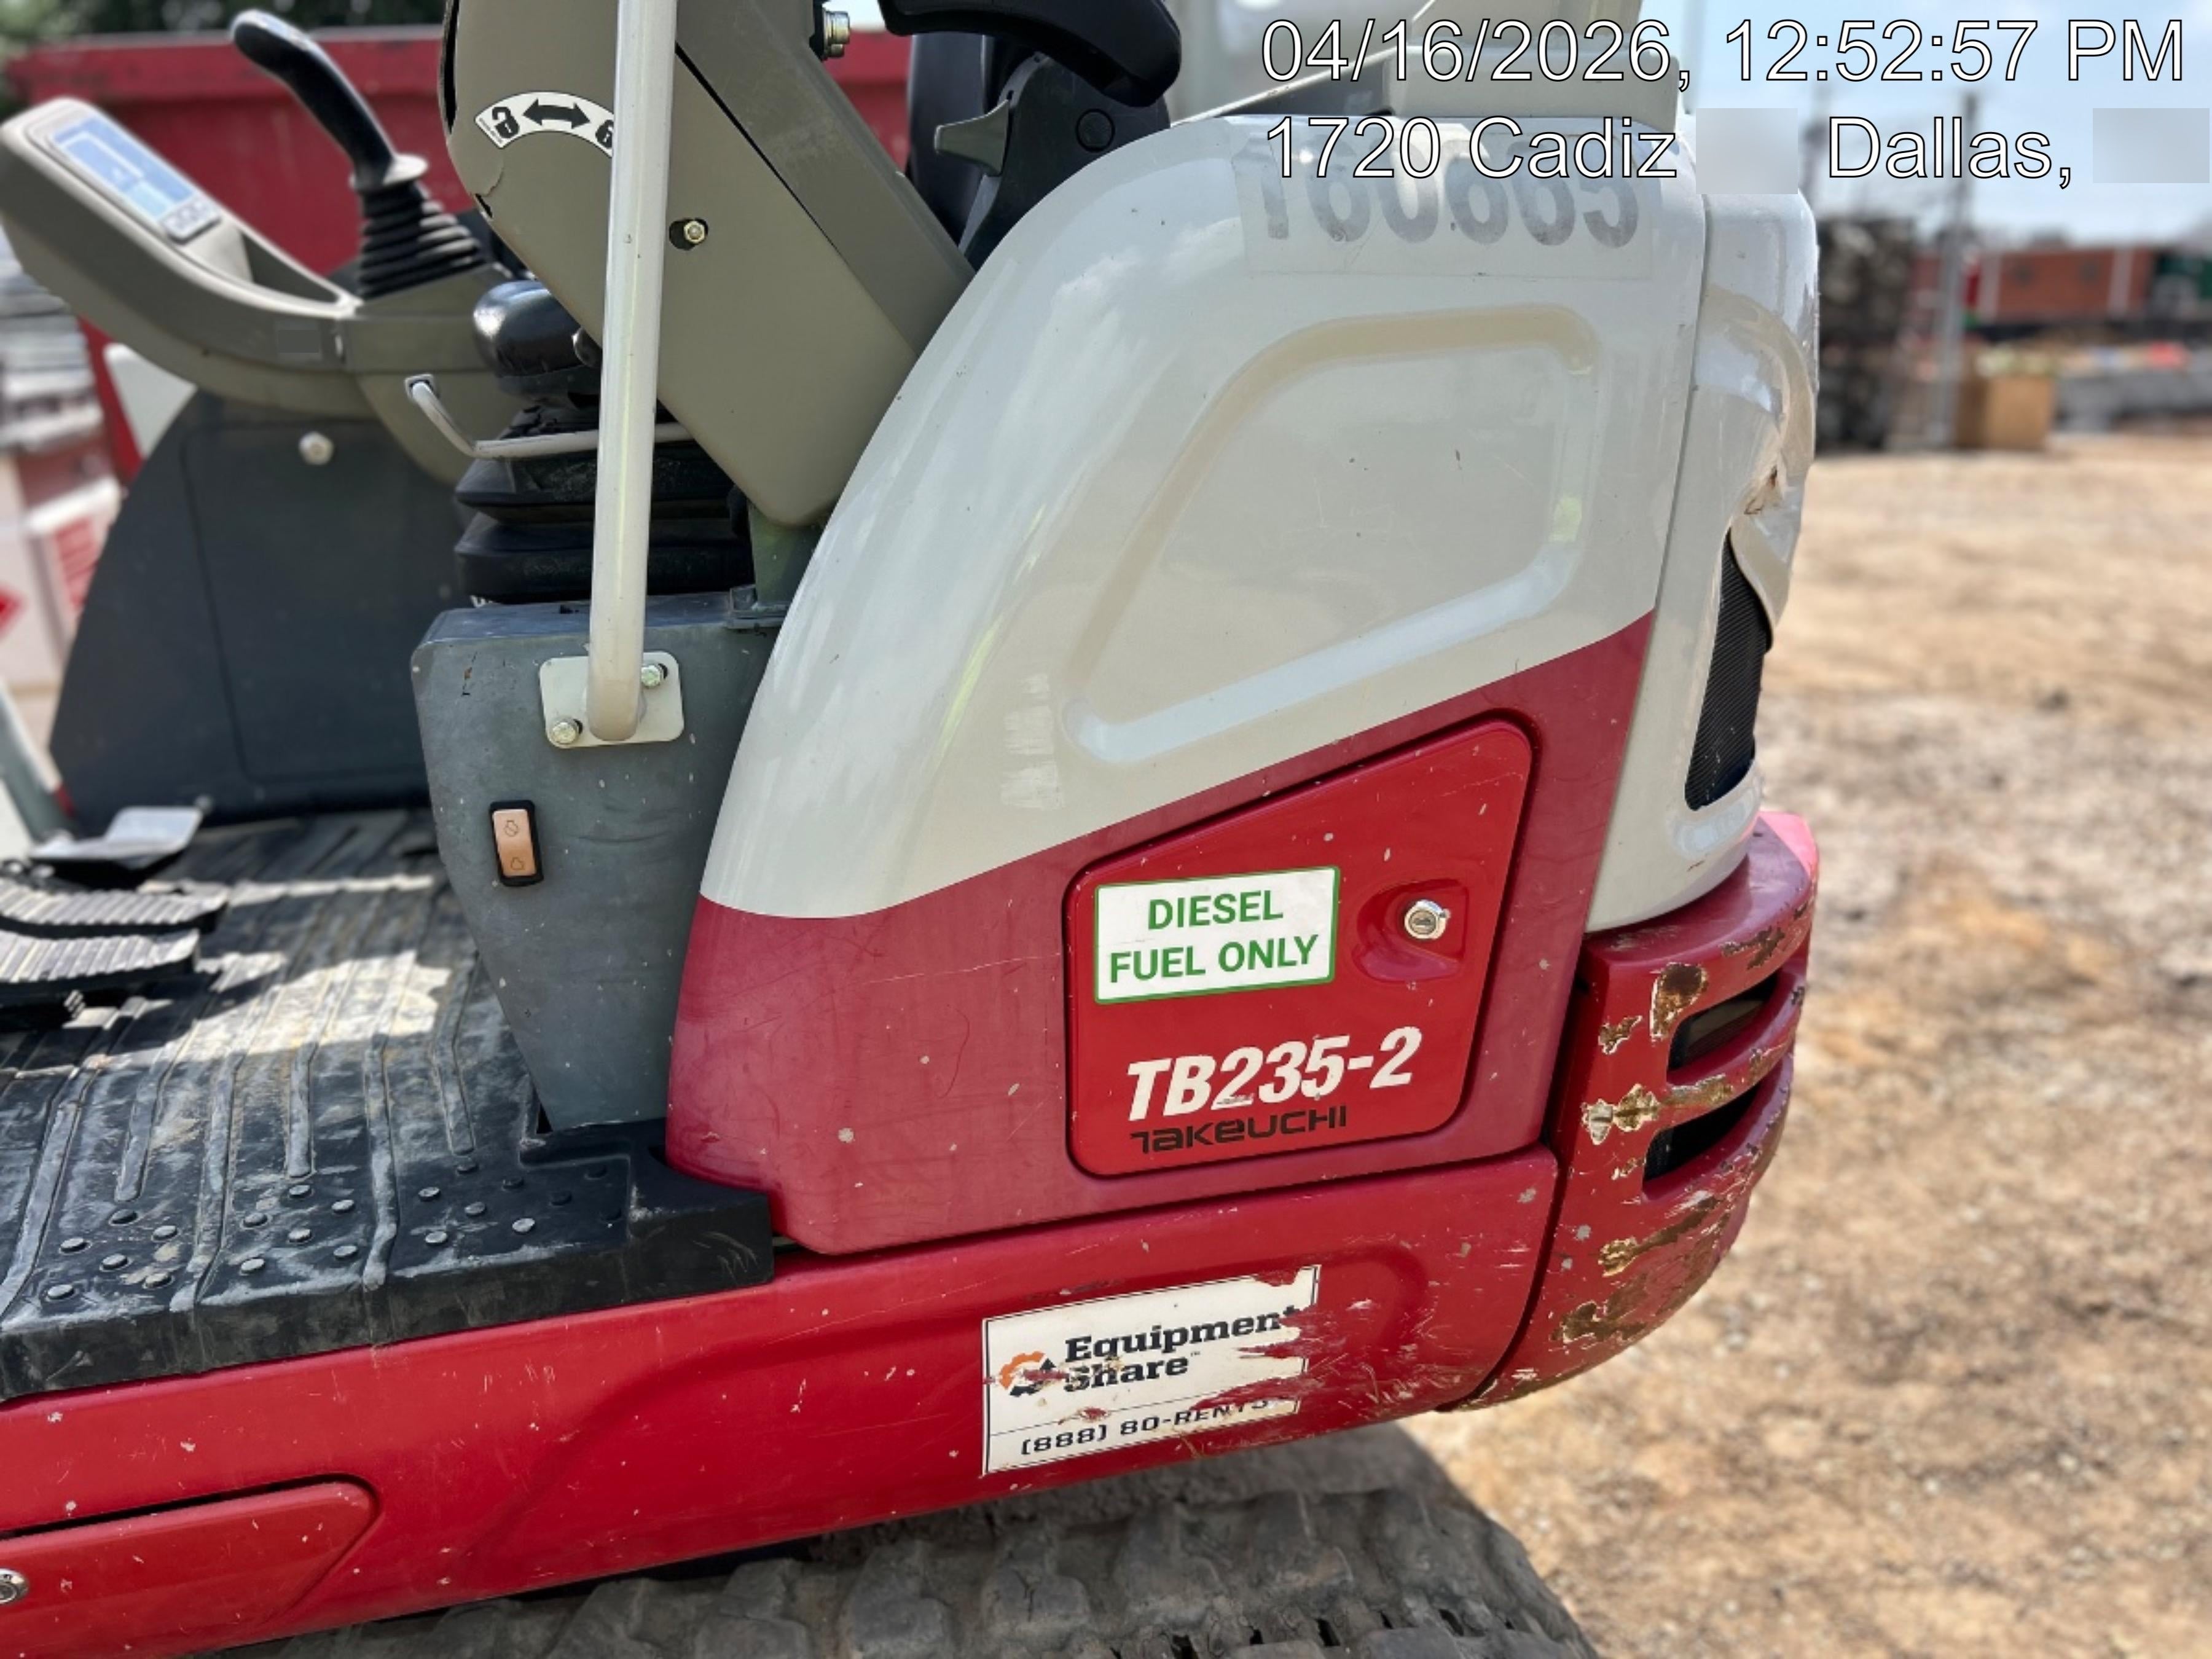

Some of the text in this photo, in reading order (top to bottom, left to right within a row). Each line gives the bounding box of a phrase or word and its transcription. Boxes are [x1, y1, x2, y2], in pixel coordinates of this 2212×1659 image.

[1148, 890, 1284, 930] DIESEL
[1110, 934, 1319, 983] FUEL ONLY
[1127, 1026, 1422, 1121] TB235-2
[1021, 1424, 1107, 1456] (888)
